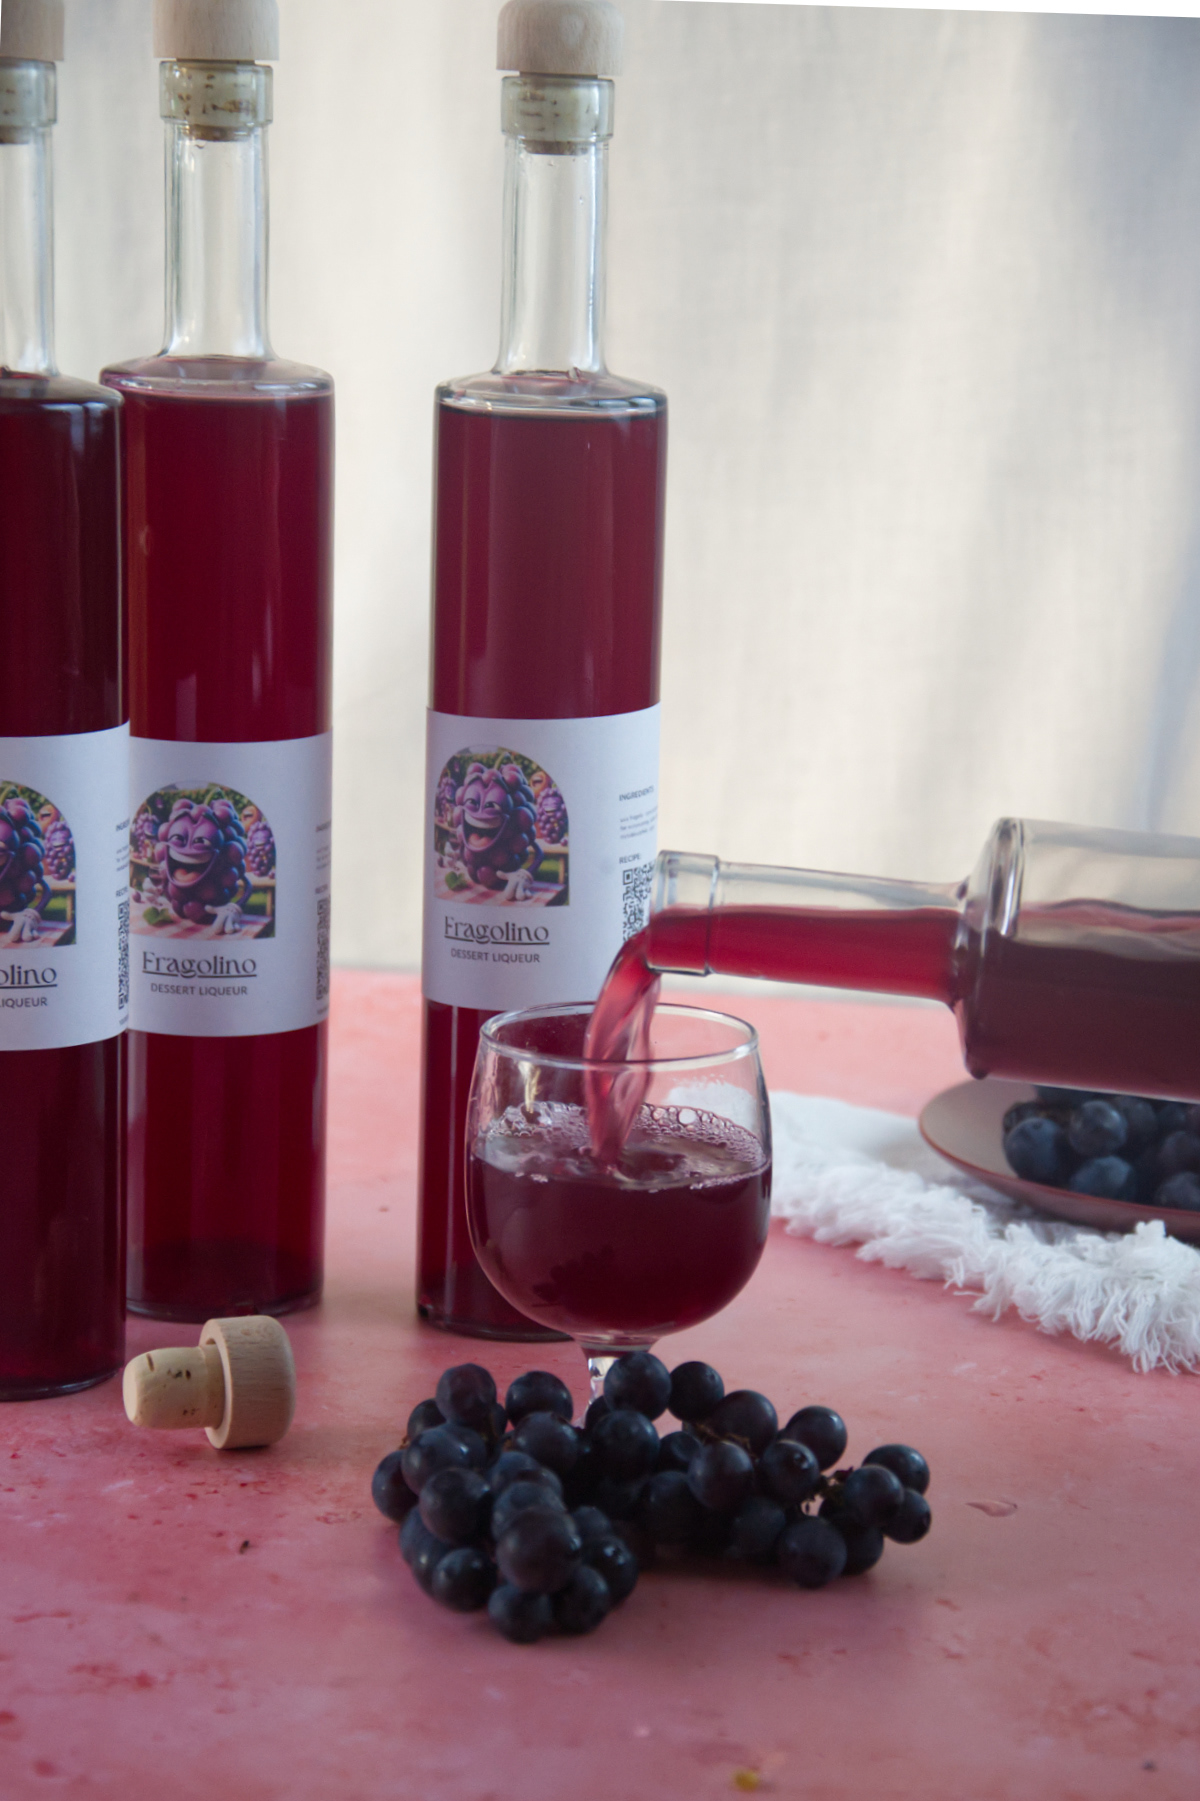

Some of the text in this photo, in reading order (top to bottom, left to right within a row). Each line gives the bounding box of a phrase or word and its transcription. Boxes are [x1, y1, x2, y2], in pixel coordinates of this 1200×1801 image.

[444, 916, 549, 945] Fragolino
[451, 948, 540, 964] DESSERT LIQUEUR
[143, 951, 256, 978] Fragolino
[150, 983, 248, 997] DESSERT LIQUEUR
[0, 996, 48, 1009] IQUEUR
